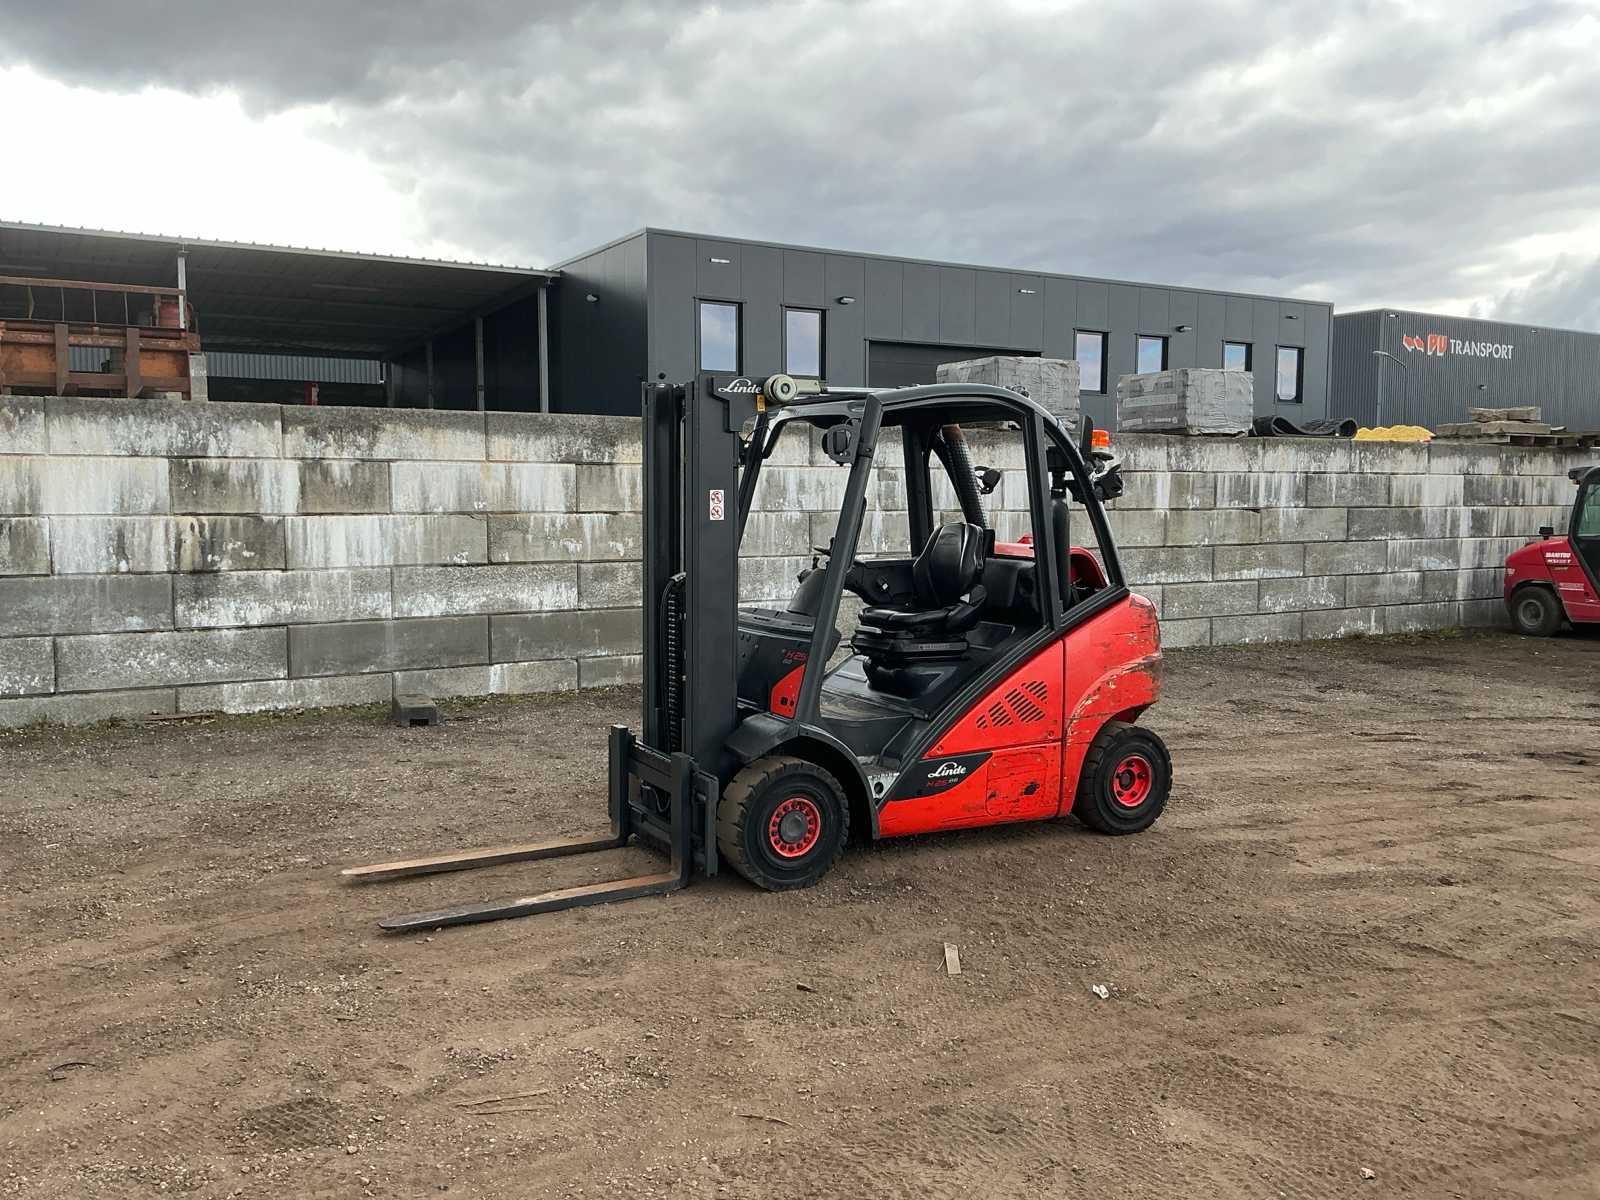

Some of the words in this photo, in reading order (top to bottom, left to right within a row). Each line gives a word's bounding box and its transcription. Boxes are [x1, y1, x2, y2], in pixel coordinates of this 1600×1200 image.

[1449, 338, 1514, 359] TRANSPORT
[718, 378, 762, 394] Linde
[927, 761, 967, 778] Linde
